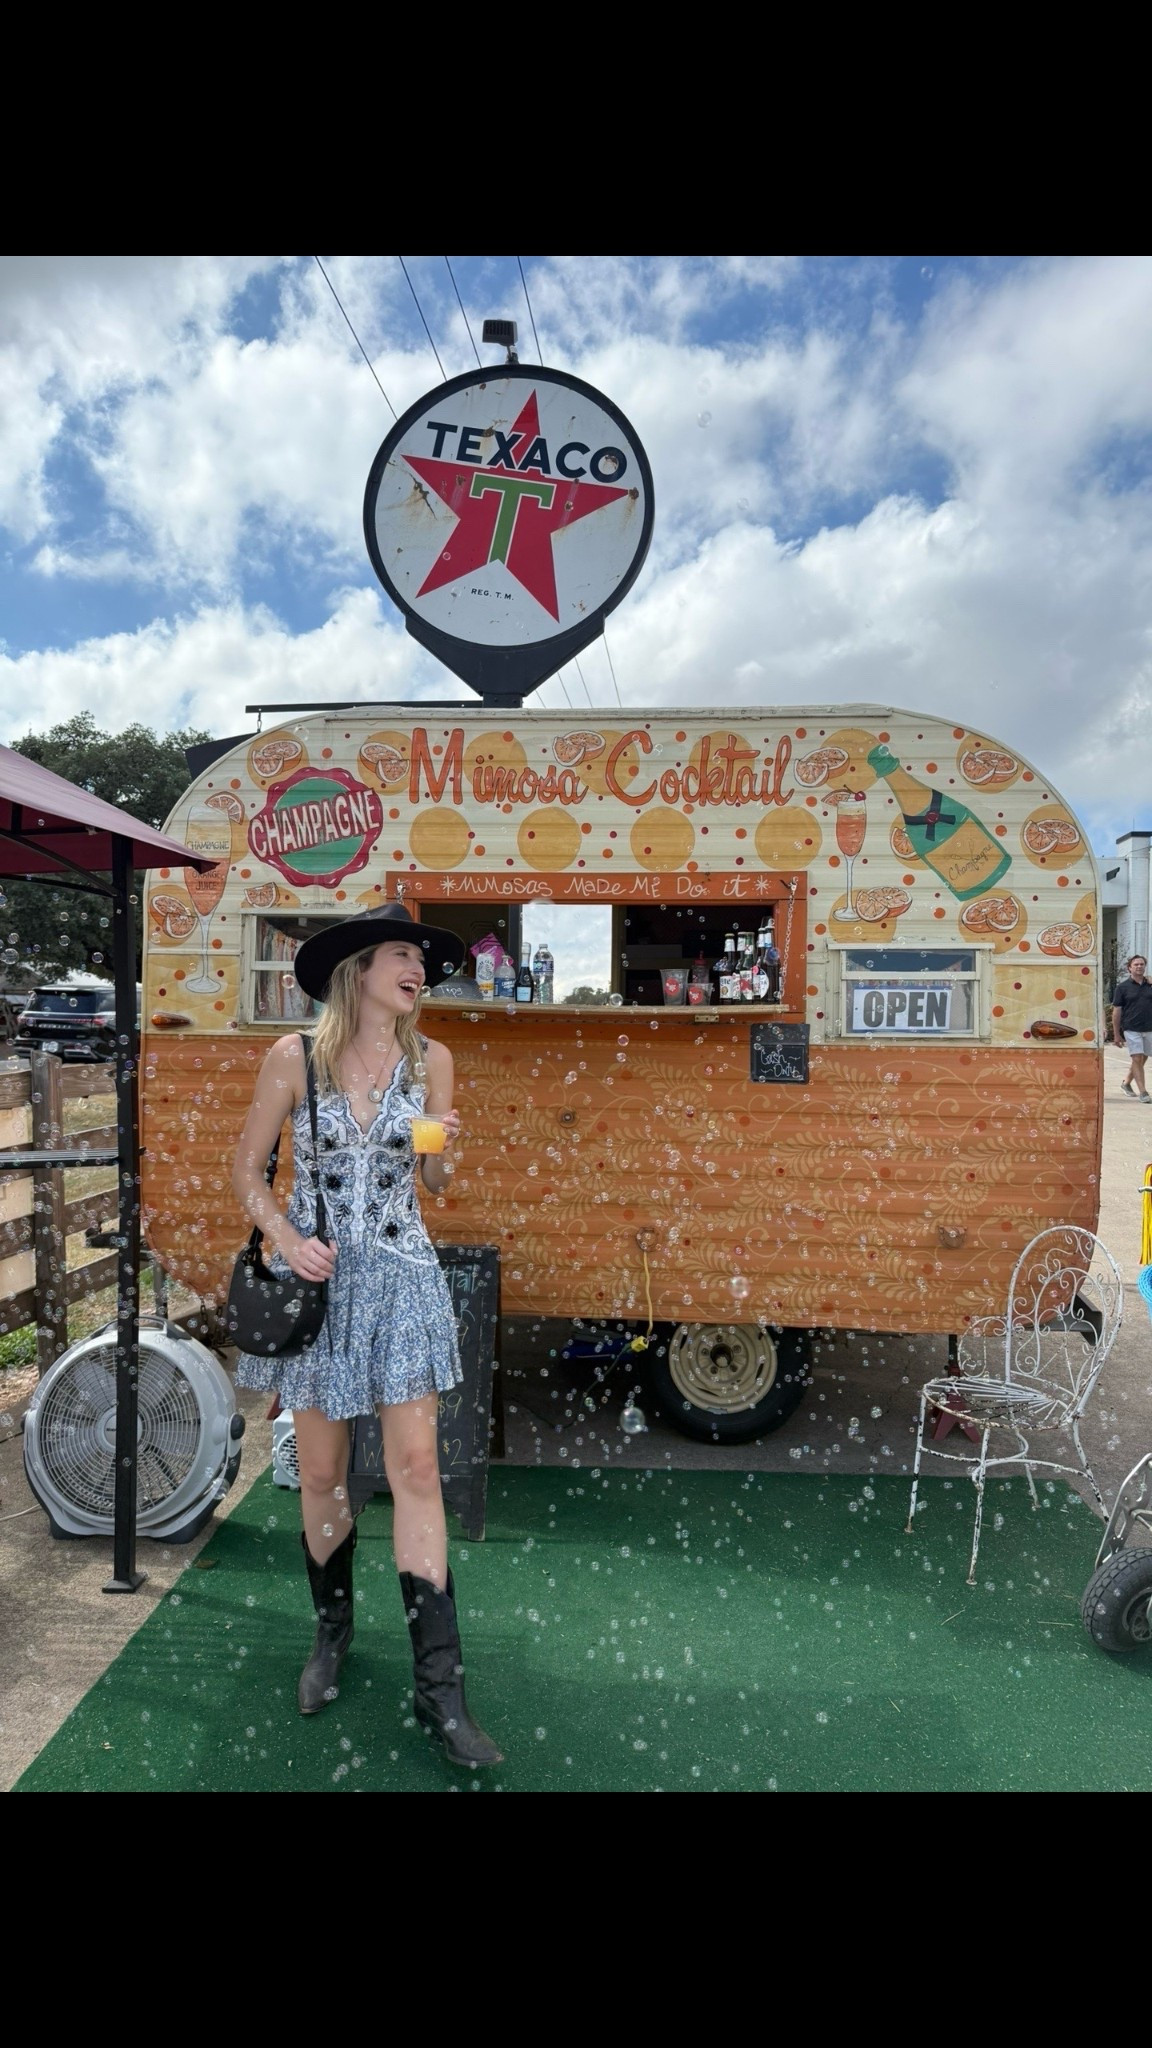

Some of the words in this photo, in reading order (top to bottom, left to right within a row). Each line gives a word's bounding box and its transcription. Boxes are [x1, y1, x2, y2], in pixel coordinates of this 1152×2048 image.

[427, 421, 627, 483] TEXACO
[470, 473, 556, 564] T
[471, 588, 492, 597] REG.
[409, 727, 589, 805] Mimosa
[605, 730, 795, 807] Cocktail
[251, 789, 380, 858] CHAMPAGNE
[187, 841, 230, 850] CHAMPAGNE
[948, 844, 994, 881] Champagne
[195, 881, 218, 891] JUICE
[723, 874, 751, 897] it
[863, 991, 948, 1028] OPEN
[443, 1438, 469, 1466] $2
